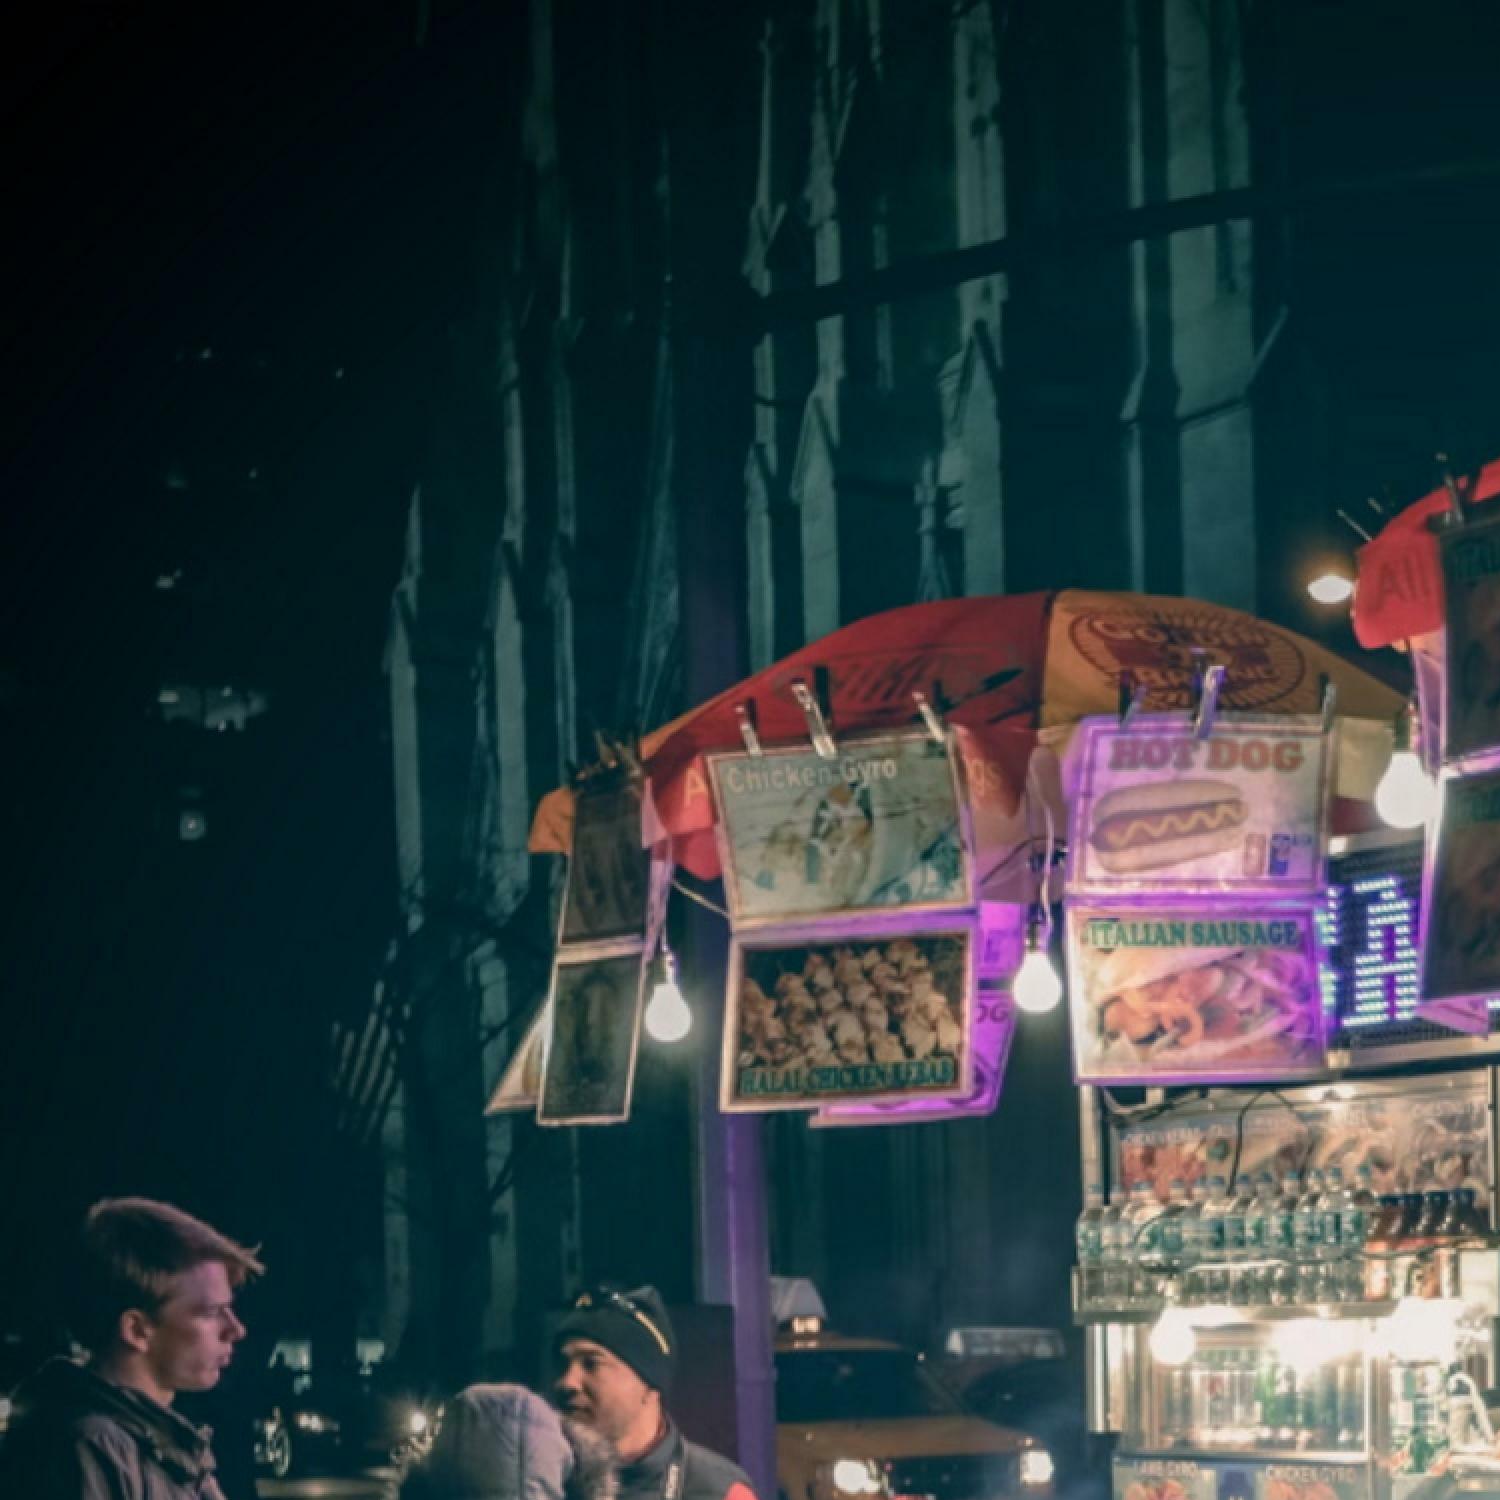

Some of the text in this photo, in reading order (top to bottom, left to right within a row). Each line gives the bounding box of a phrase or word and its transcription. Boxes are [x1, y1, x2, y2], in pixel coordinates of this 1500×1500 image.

[1108, 738, 1305, 772] HOT DOG
[725, 761, 835, 795] Chicken
[842, 757, 898, 789] Gyro
[1191, 919, 1298, 947] SAUSAGE
